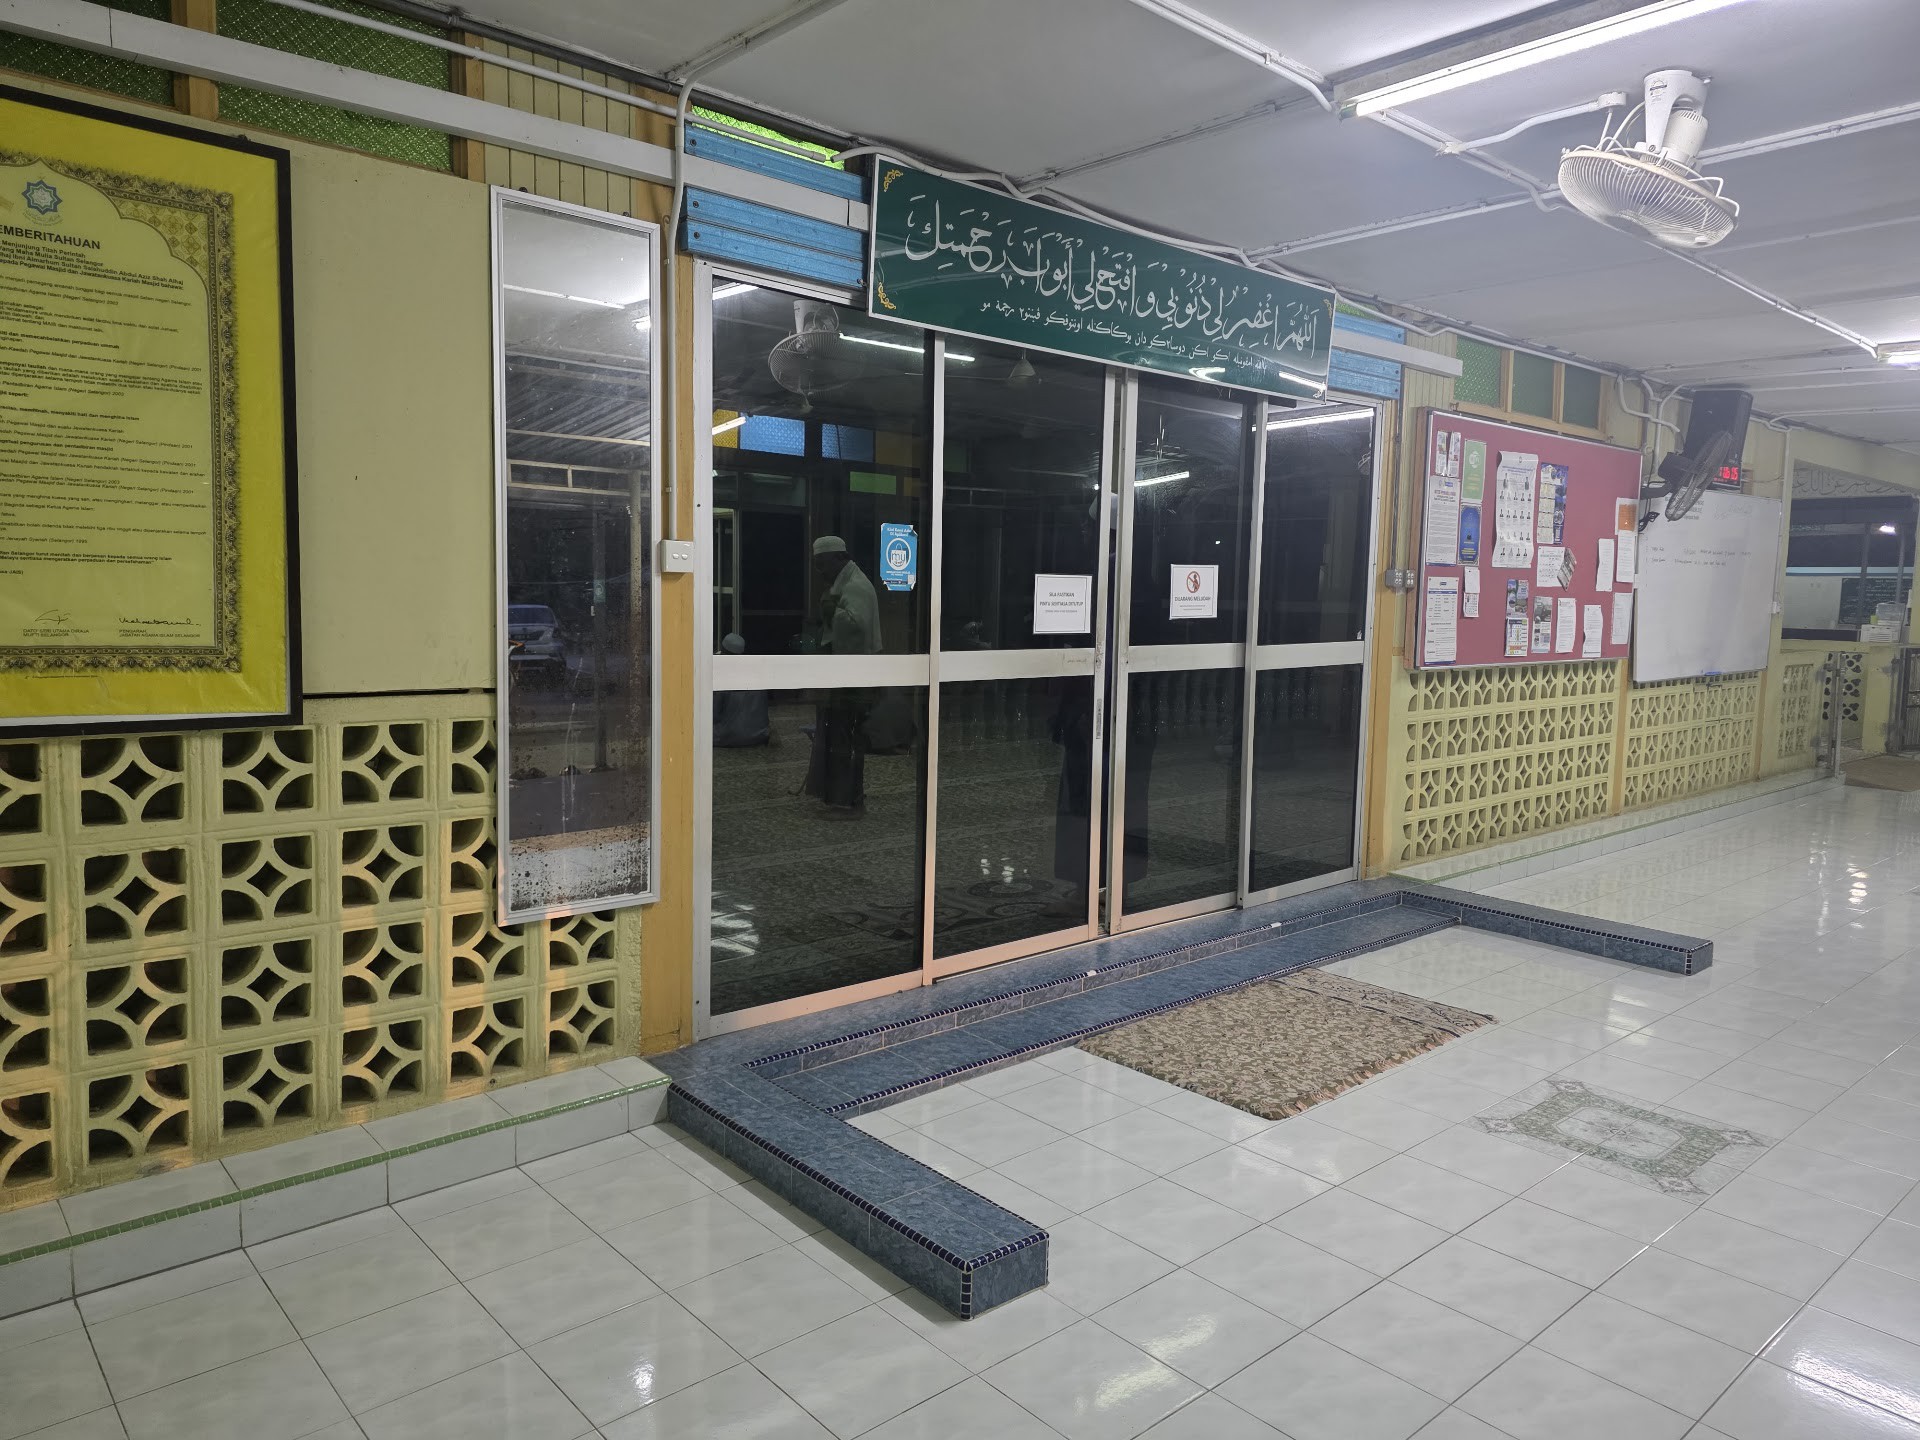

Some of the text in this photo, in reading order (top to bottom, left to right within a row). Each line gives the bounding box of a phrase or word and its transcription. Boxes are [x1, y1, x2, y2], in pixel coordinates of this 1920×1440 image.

[0, 225, 100, 249] MBERITAHUAN
[59, 250, 85, 258] Perintah
[75, 258, 103, 267] Selangor
[19, 261, 45, 269] Pegawai
[141, 278, 159, 286] Masjid
